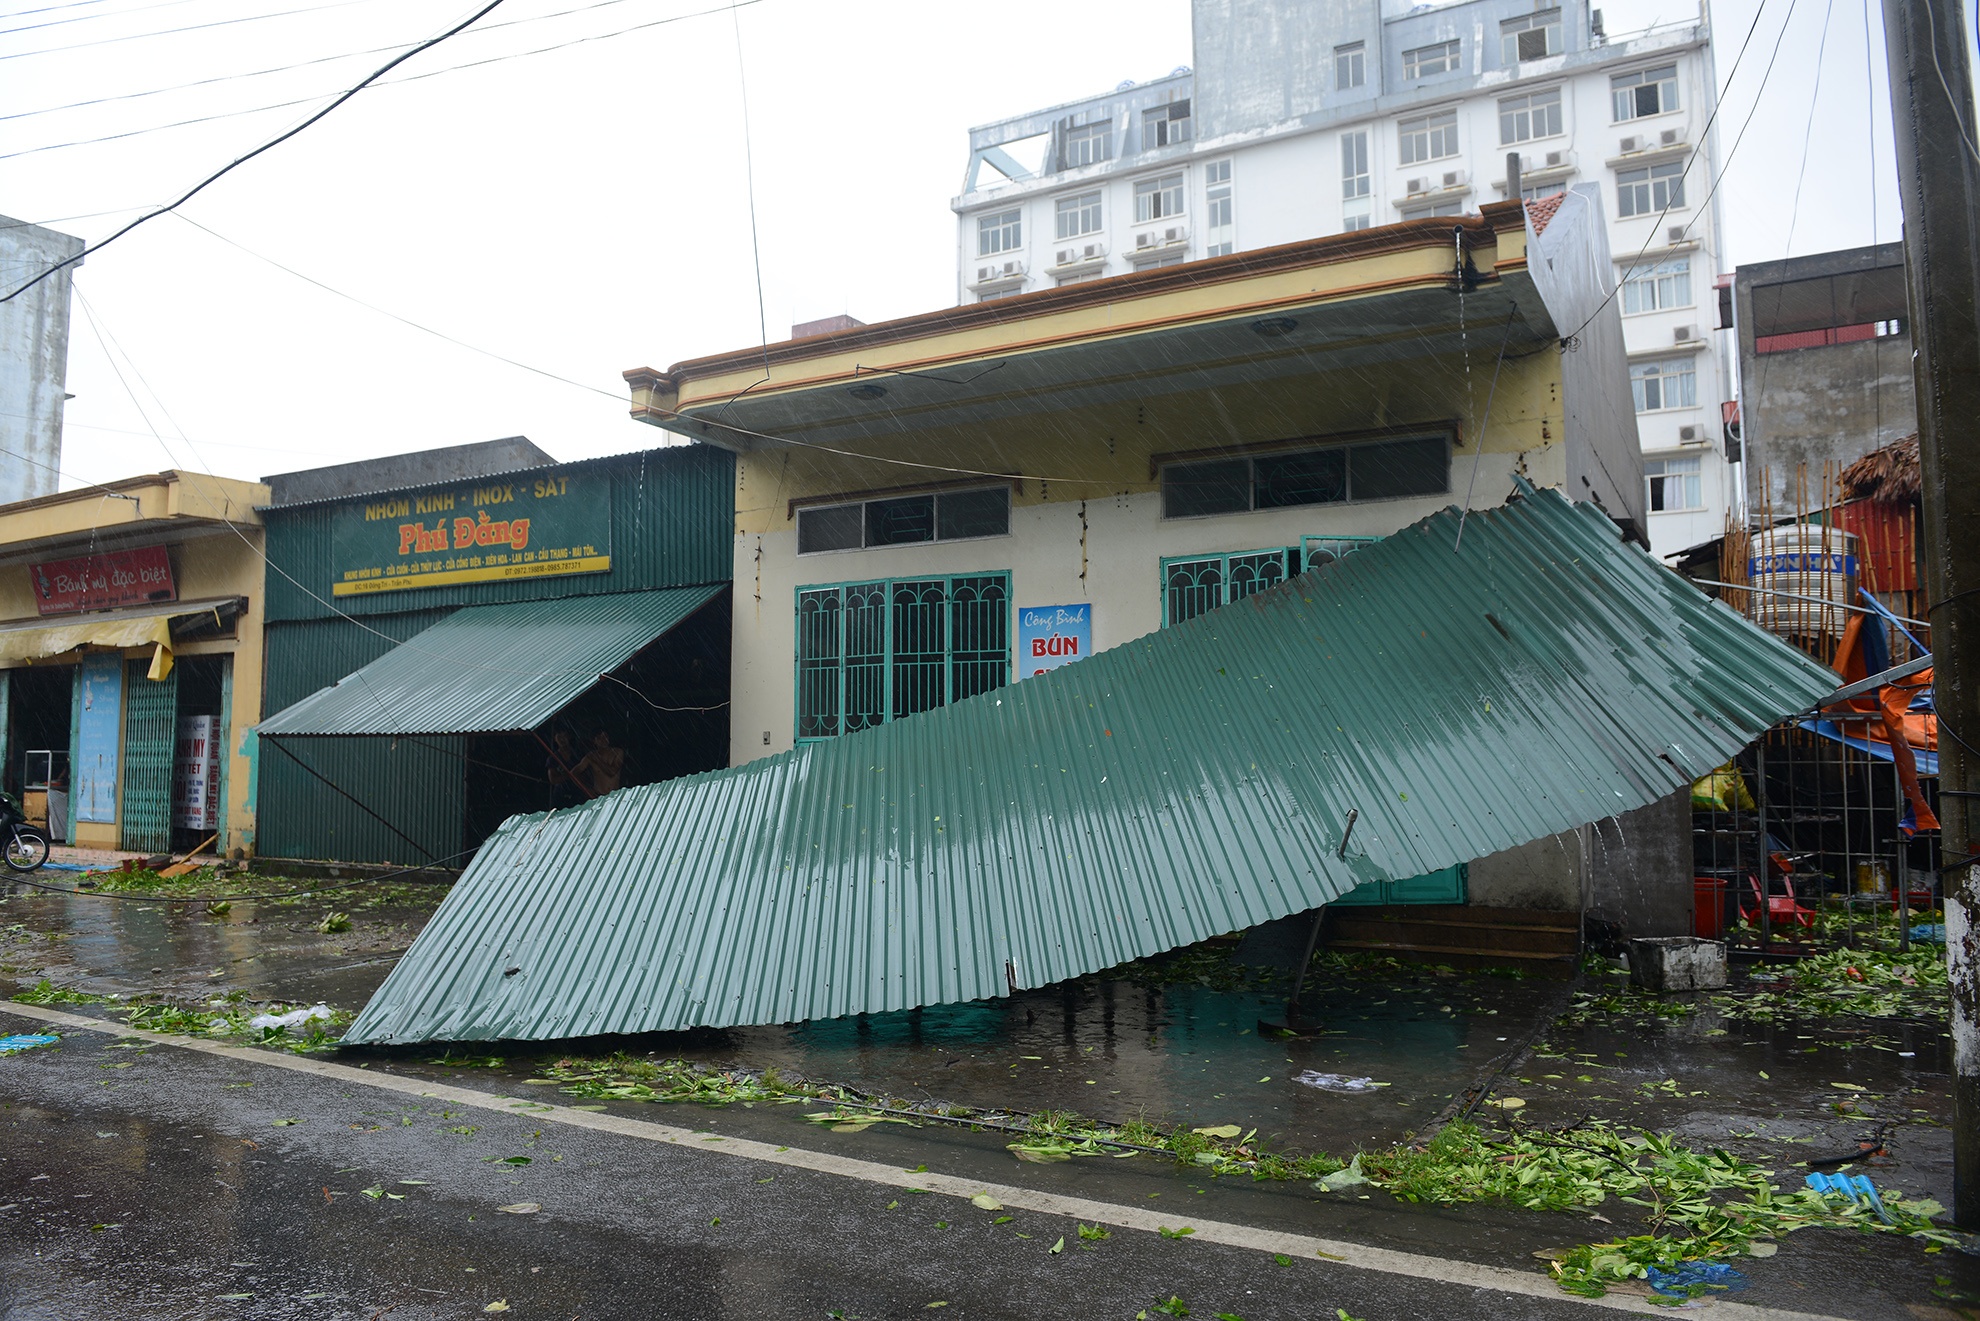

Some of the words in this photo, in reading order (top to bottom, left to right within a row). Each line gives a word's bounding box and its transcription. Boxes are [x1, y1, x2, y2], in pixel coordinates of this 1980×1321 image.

[365, 498, 409, 521] NHÔM
[416, 491, 455, 514] KÍNH
[473, 485, 514, 506] INOX
[398, 518, 449, 555] Phú
[453, 510, 530, 550] Đằng
[54, 574, 88, 593] Bánh
[111, 570, 137, 588] đặc
[140, 567, 167, 583] biệt
[1024, 611, 1053, 631] Công
[1056, 607, 1084, 626] Bình
[1031, 632, 1078, 657] BÚN
